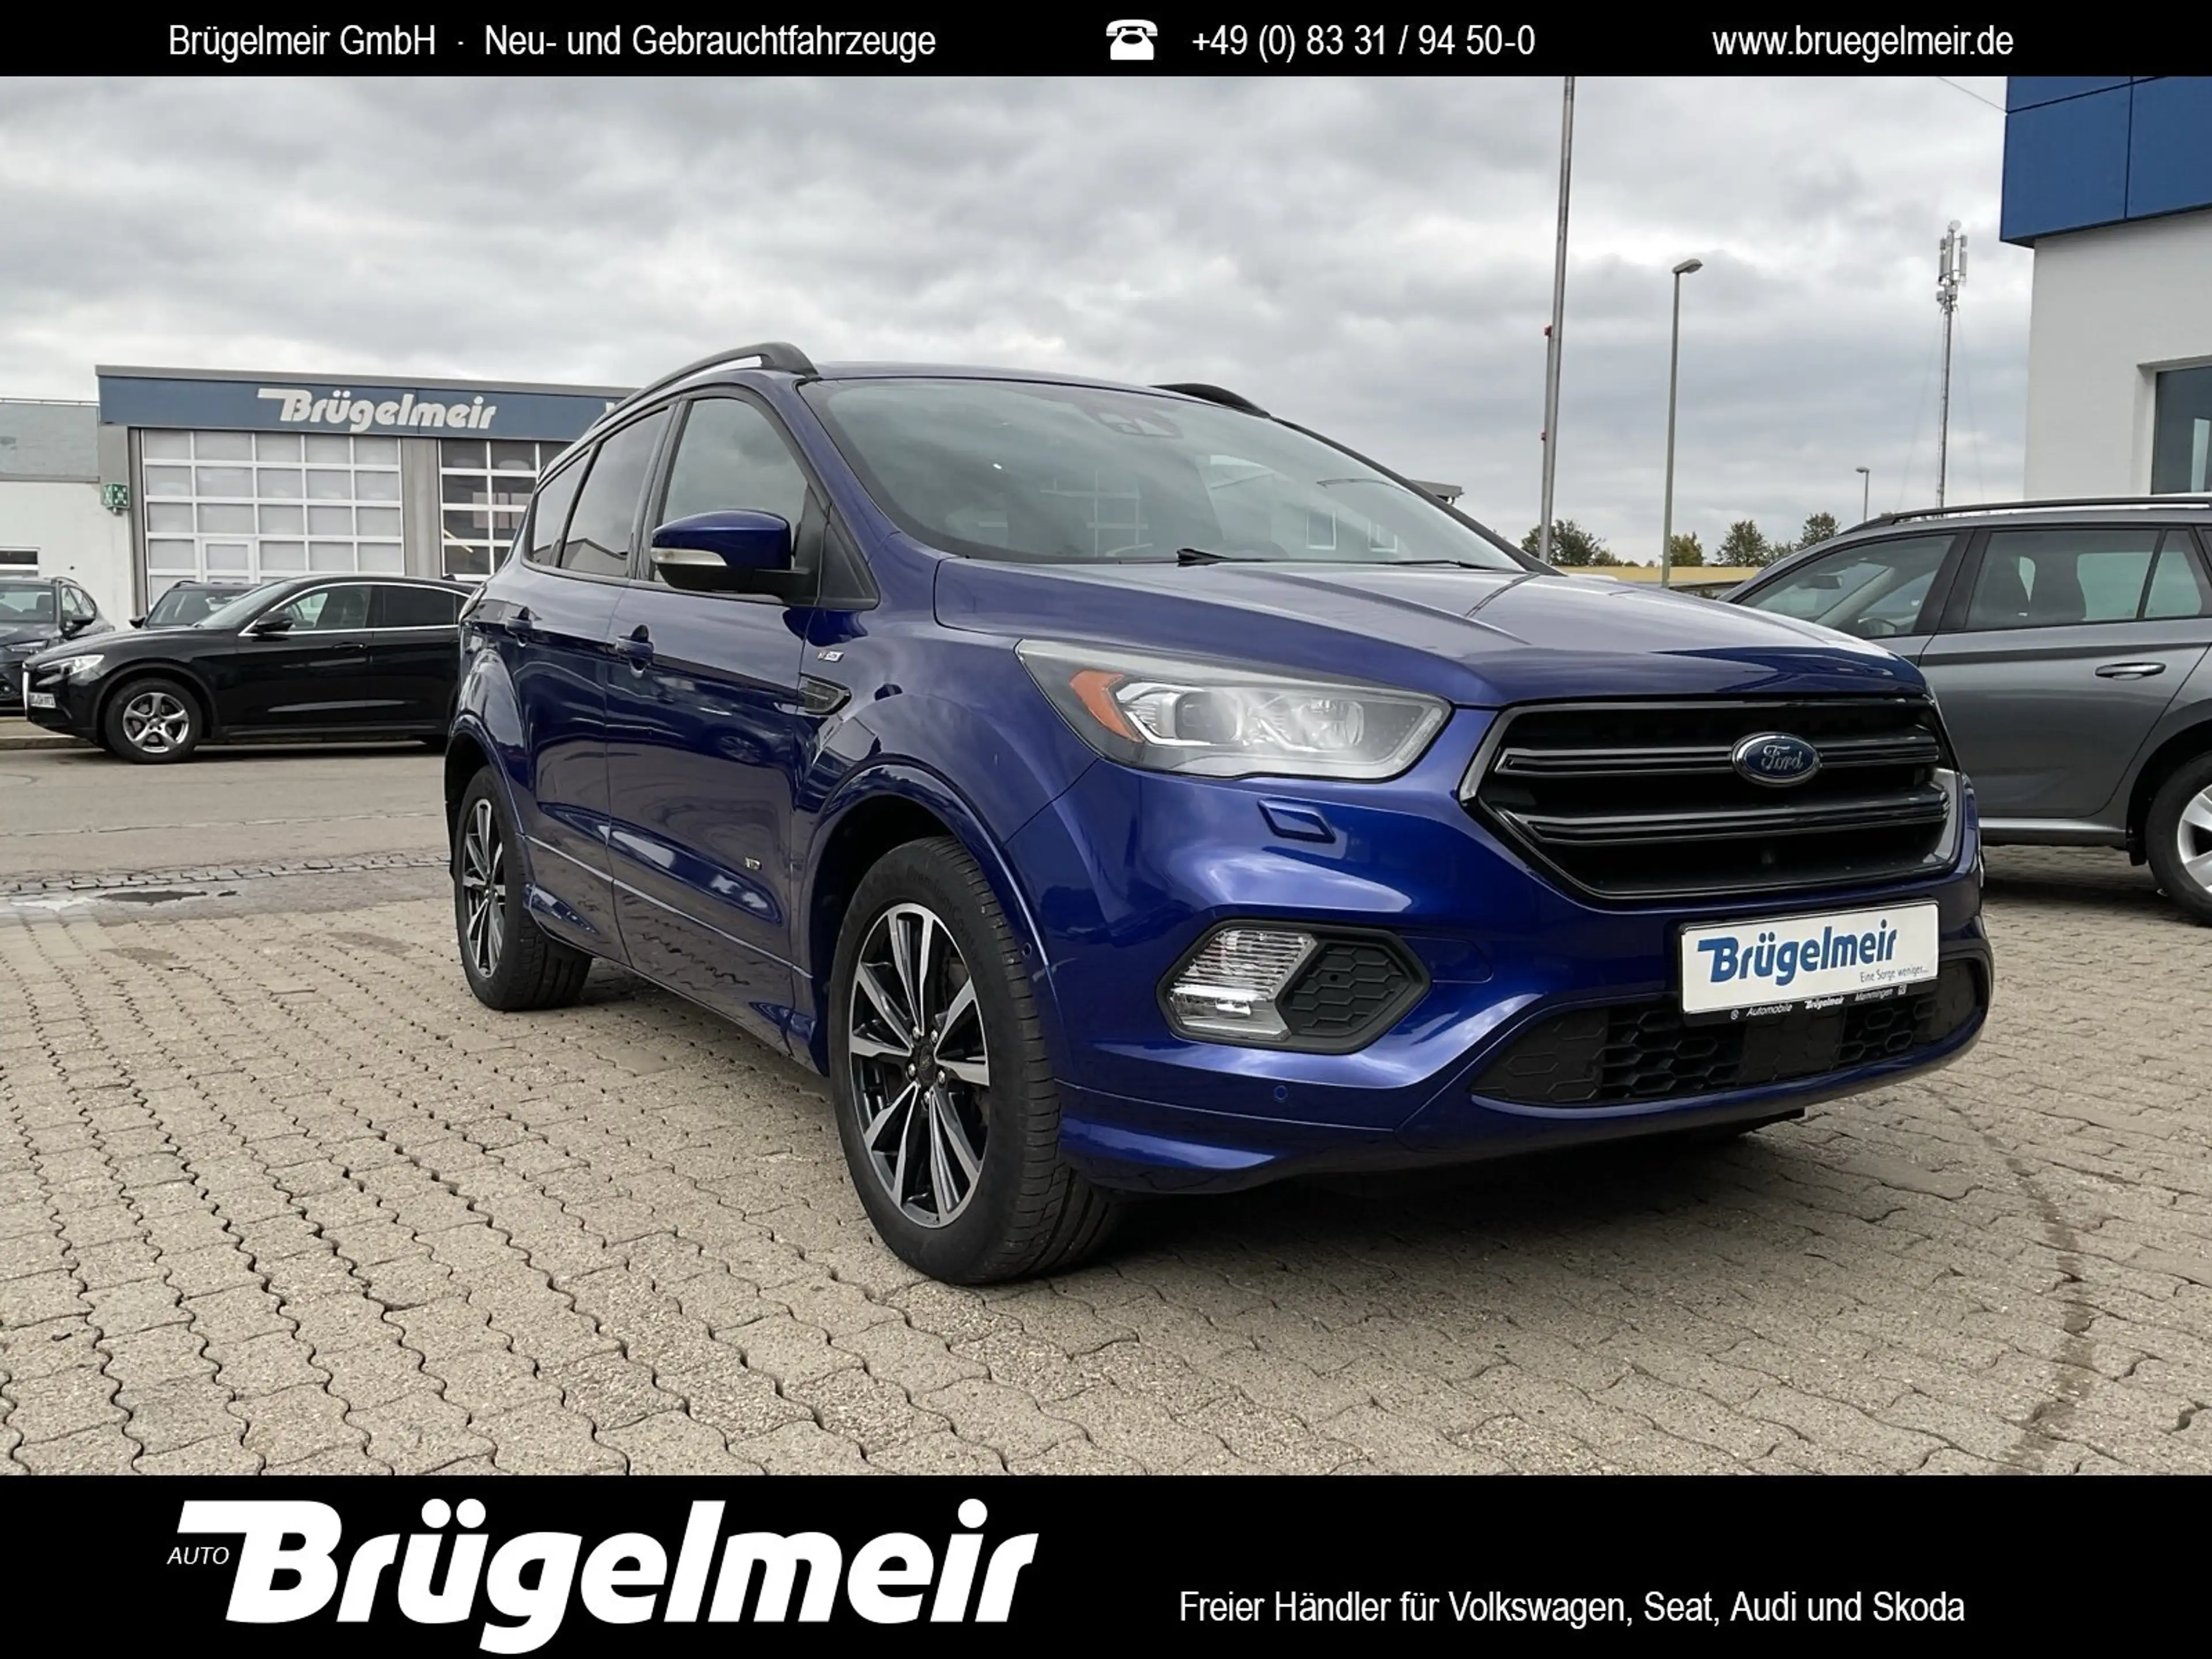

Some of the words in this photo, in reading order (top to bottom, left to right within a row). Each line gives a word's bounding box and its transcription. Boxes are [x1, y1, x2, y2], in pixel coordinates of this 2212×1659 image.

[257, 388, 497, 433] Brügelmeir
[1761, 745, 1804, 770] Ford
[1697, 919, 1897, 986] Brügelmeir
[1746, 1003, 1793, 1017] Automobile
